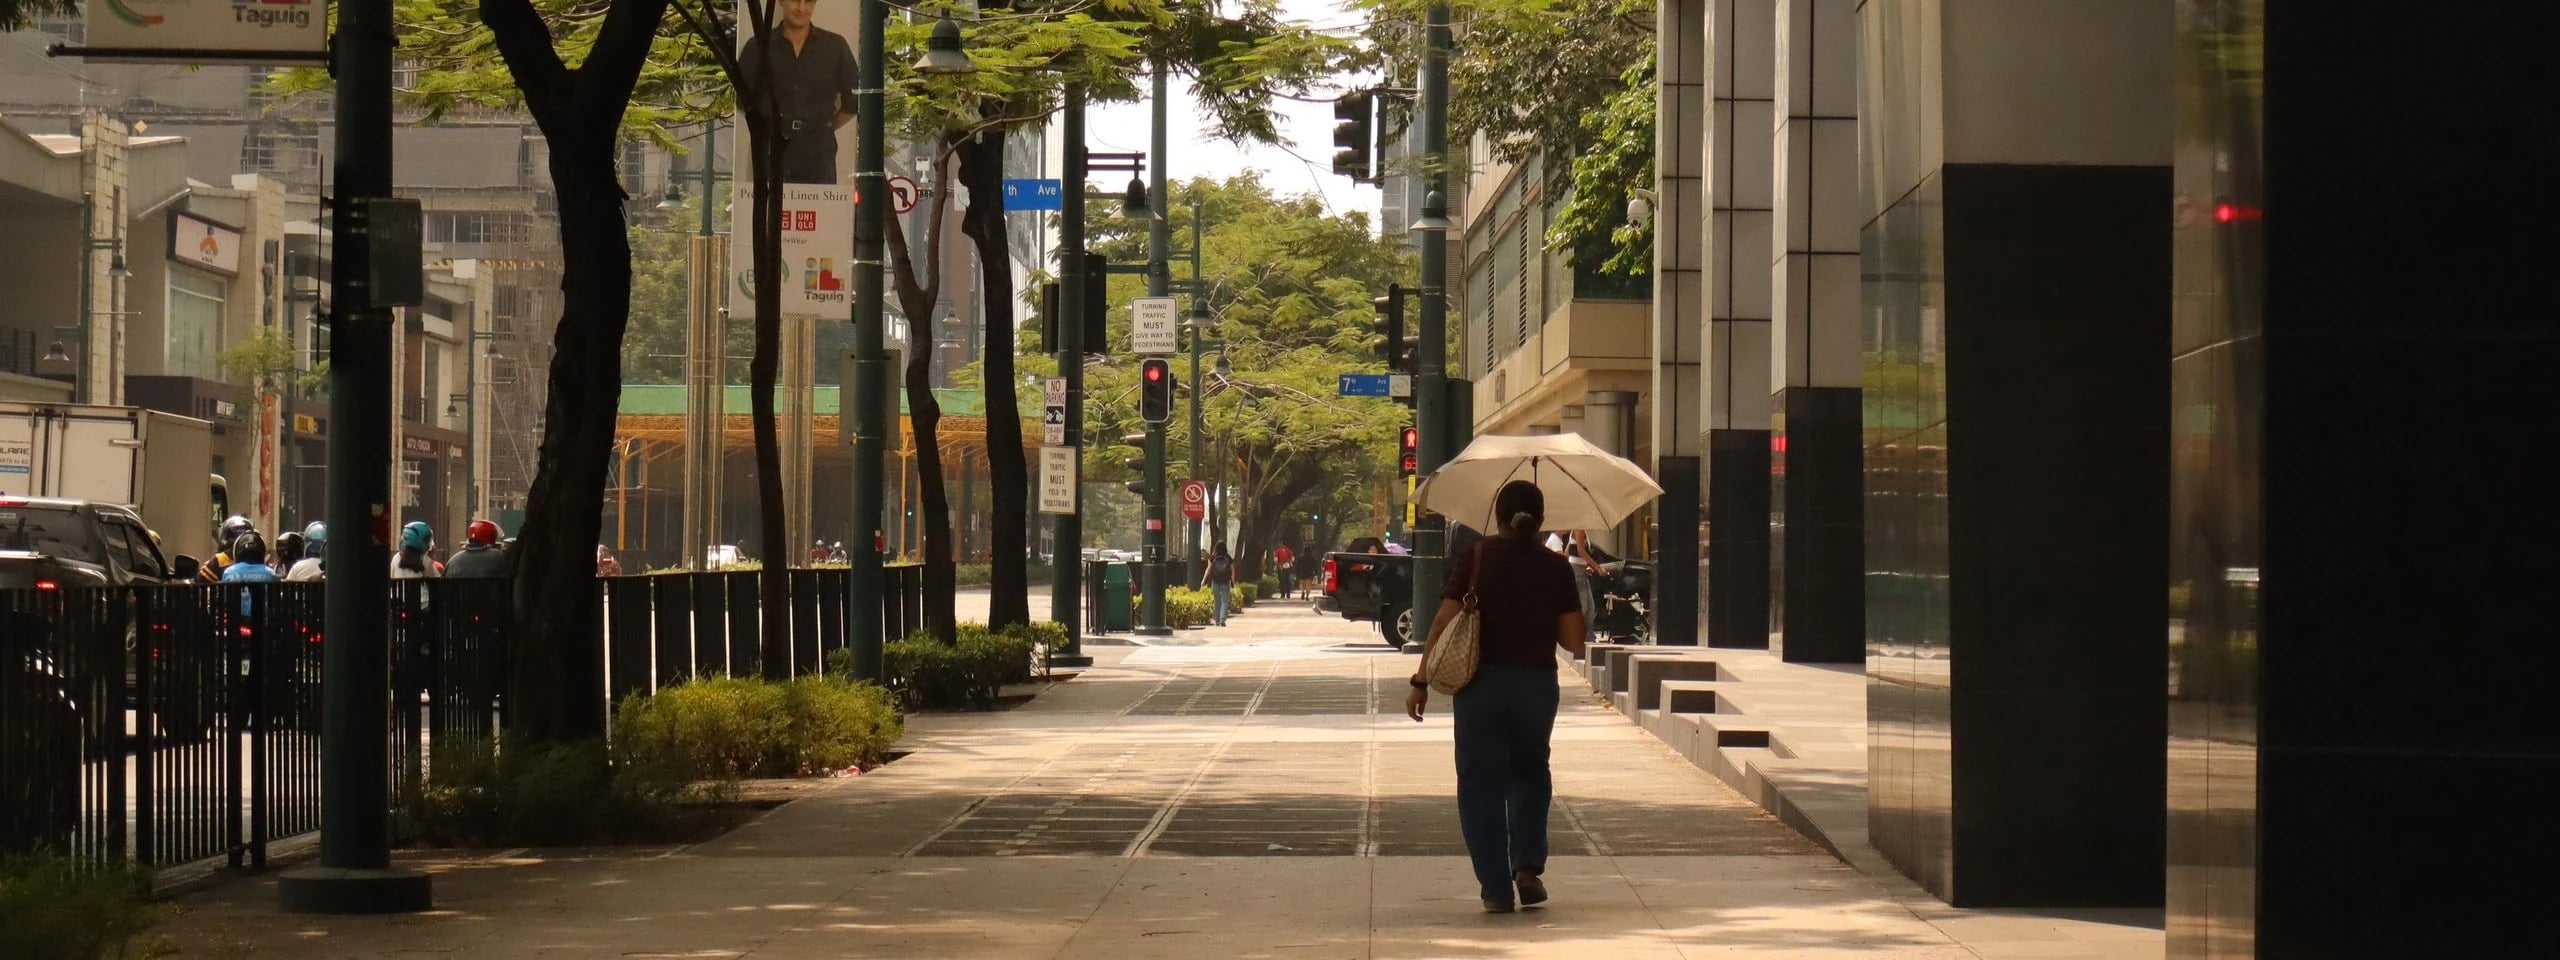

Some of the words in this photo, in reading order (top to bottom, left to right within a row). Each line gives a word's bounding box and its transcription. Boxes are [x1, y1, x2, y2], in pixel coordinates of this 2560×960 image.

[232, 6, 311, 28] Taguig
[790, 190, 820, 200] Linen
[823, 190, 849, 201] Shirt
[1038, 184, 1057, 196] Ave
[798, 213, 813, 221] UNI
[804, 291, 844, 302] Taguig
[1051, 380, 1061, 392] NO
[1046, 391, 1065, 404] PARKING
[1050, 463, 1066, 471] TRAFFIC
[1050, 474, 1065, 484] MUST
[1048, 488, 1060, 496] YIELD
[1043, 499, 1071, 508] PEDESTRIANS
